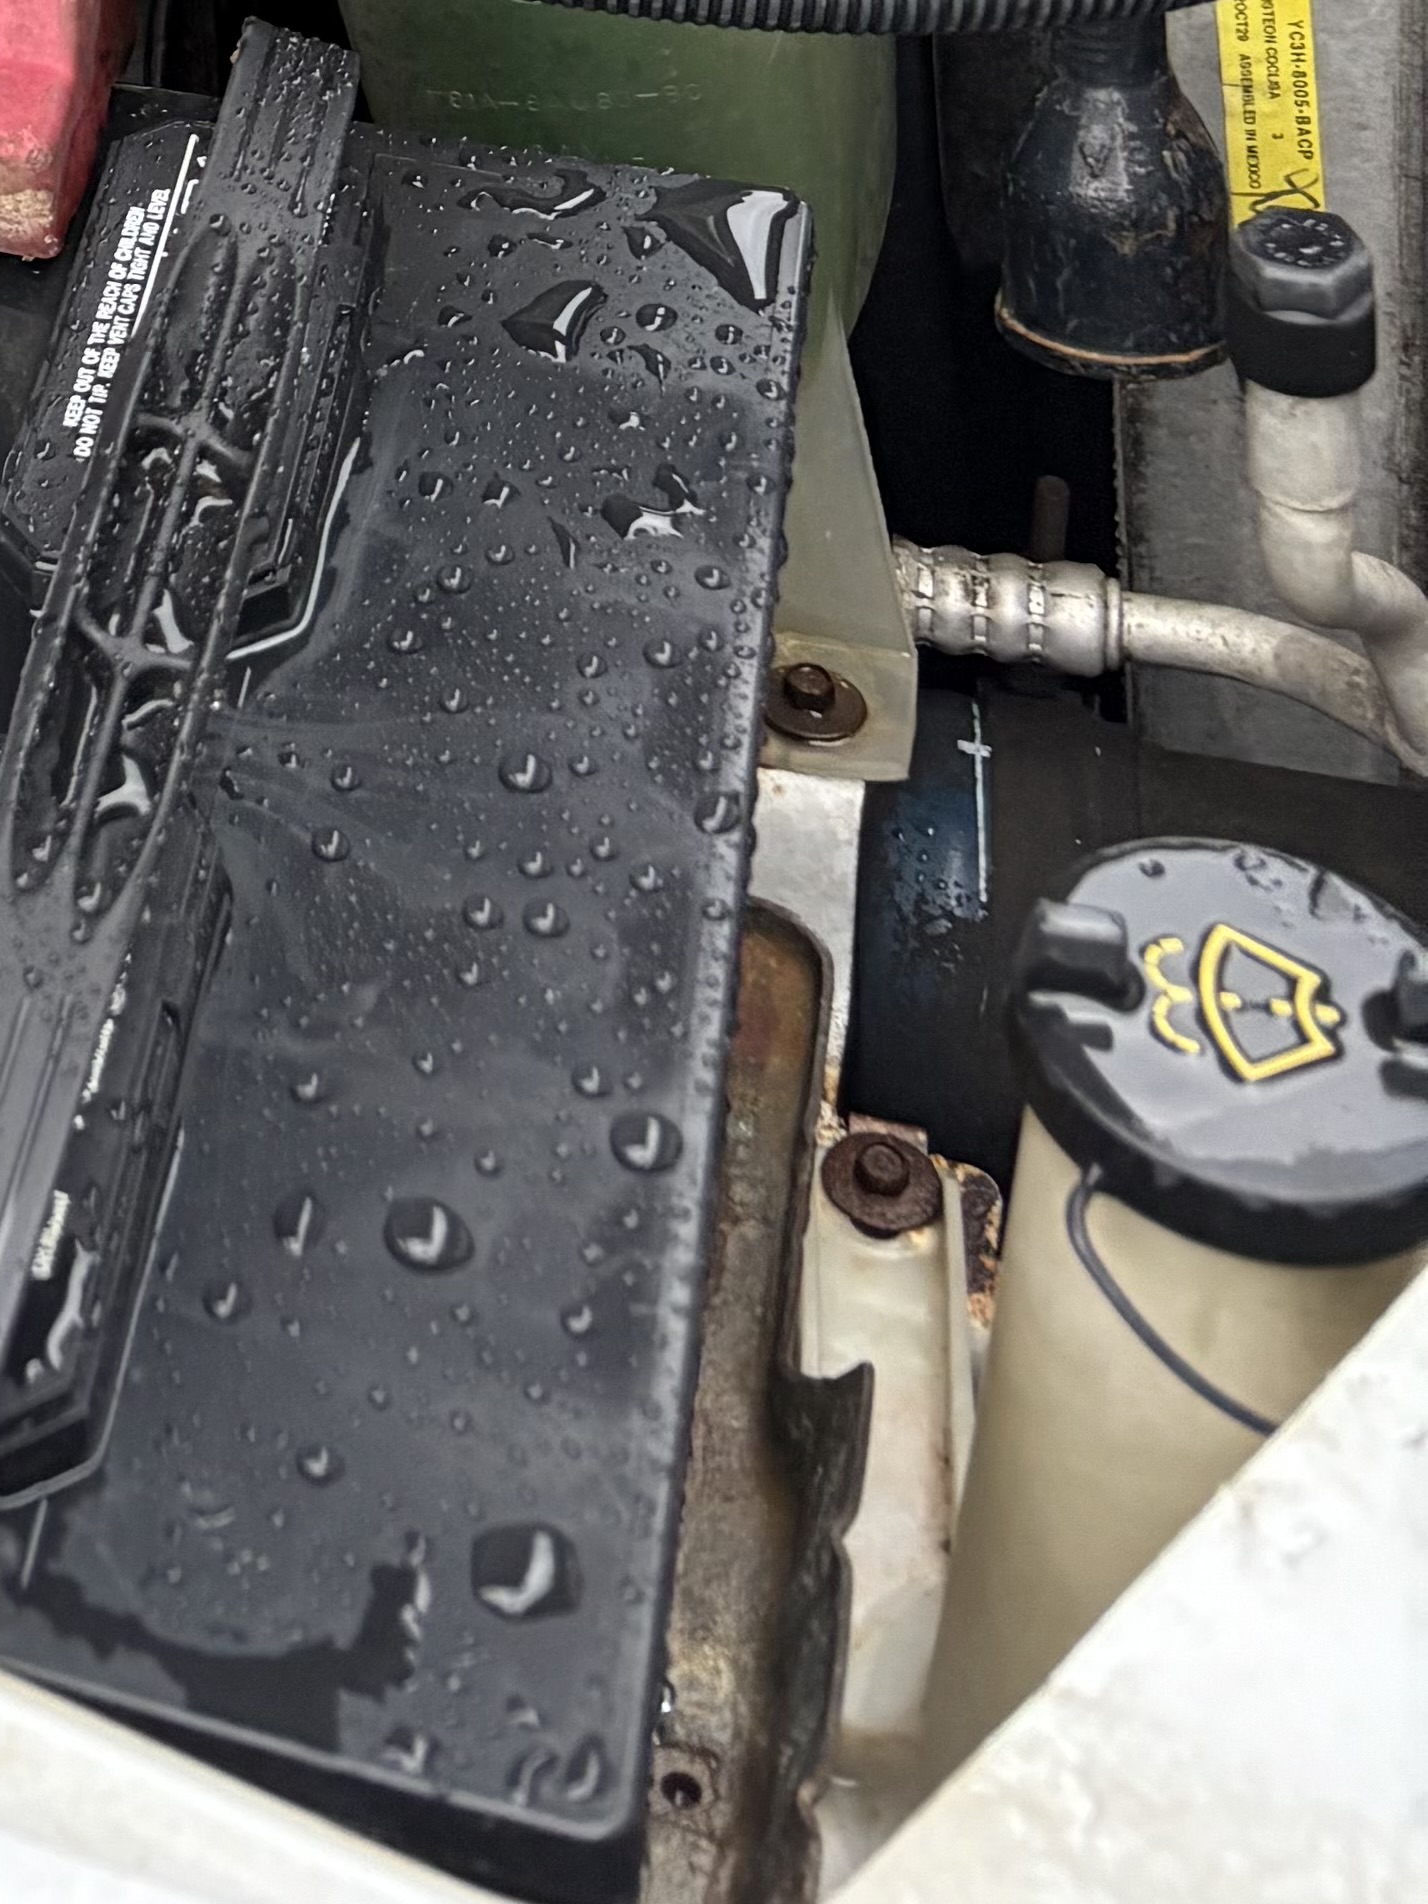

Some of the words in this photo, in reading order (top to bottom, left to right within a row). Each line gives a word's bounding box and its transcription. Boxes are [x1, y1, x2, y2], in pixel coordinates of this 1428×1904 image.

[147, 188, 171, 222] LEVEL
[114, 205, 145, 261] CHILDREN
[138, 221, 161, 246] AND
[109, 261, 128, 281] OF
[128, 242, 153, 283] TIGHT
[96, 279, 123, 320] REACH
[118, 283, 142, 315] CAPS
[87, 320, 111, 348] THE
[107, 313, 130, 348] VENT
[81, 347, 101, 369] OF
[97, 347, 121, 379] KEEP
[73, 365, 95, 393] OUT
[91, 382, 112, 405] TIP.
[62, 394, 87, 428] KEEP
[81, 405, 104, 435] NOT
[75, 436, 94, 458] DO
